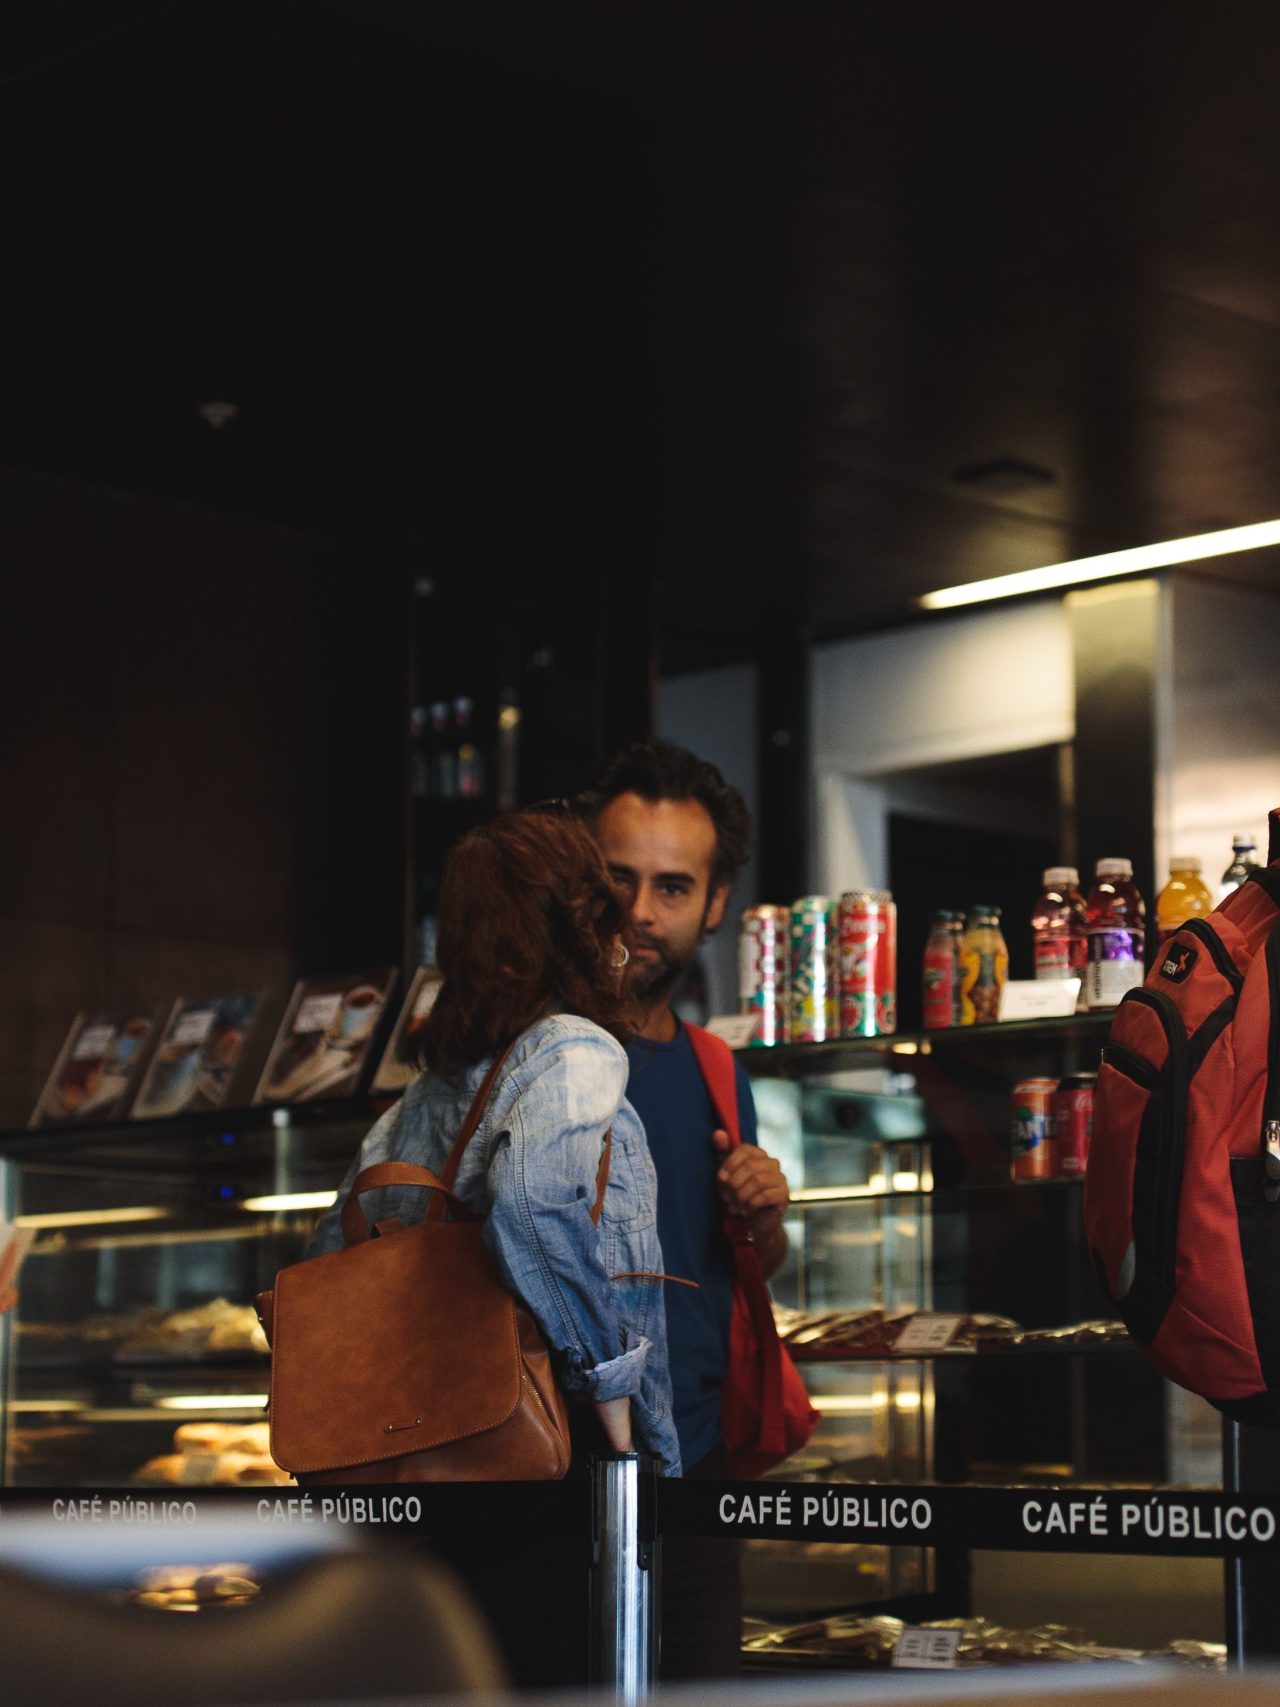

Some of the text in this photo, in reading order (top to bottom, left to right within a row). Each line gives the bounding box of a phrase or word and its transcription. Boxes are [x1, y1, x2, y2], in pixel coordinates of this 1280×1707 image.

[53, 1494, 197, 1525] CAFÉ PÚBLICO
[257, 1492, 422, 1523] CAFÉ PÚBLICO
[719, 1489, 932, 1529] CAFÉ PÚBLICO
[1022, 1495, 1276, 1542] CAFÉ PÚBLICO
